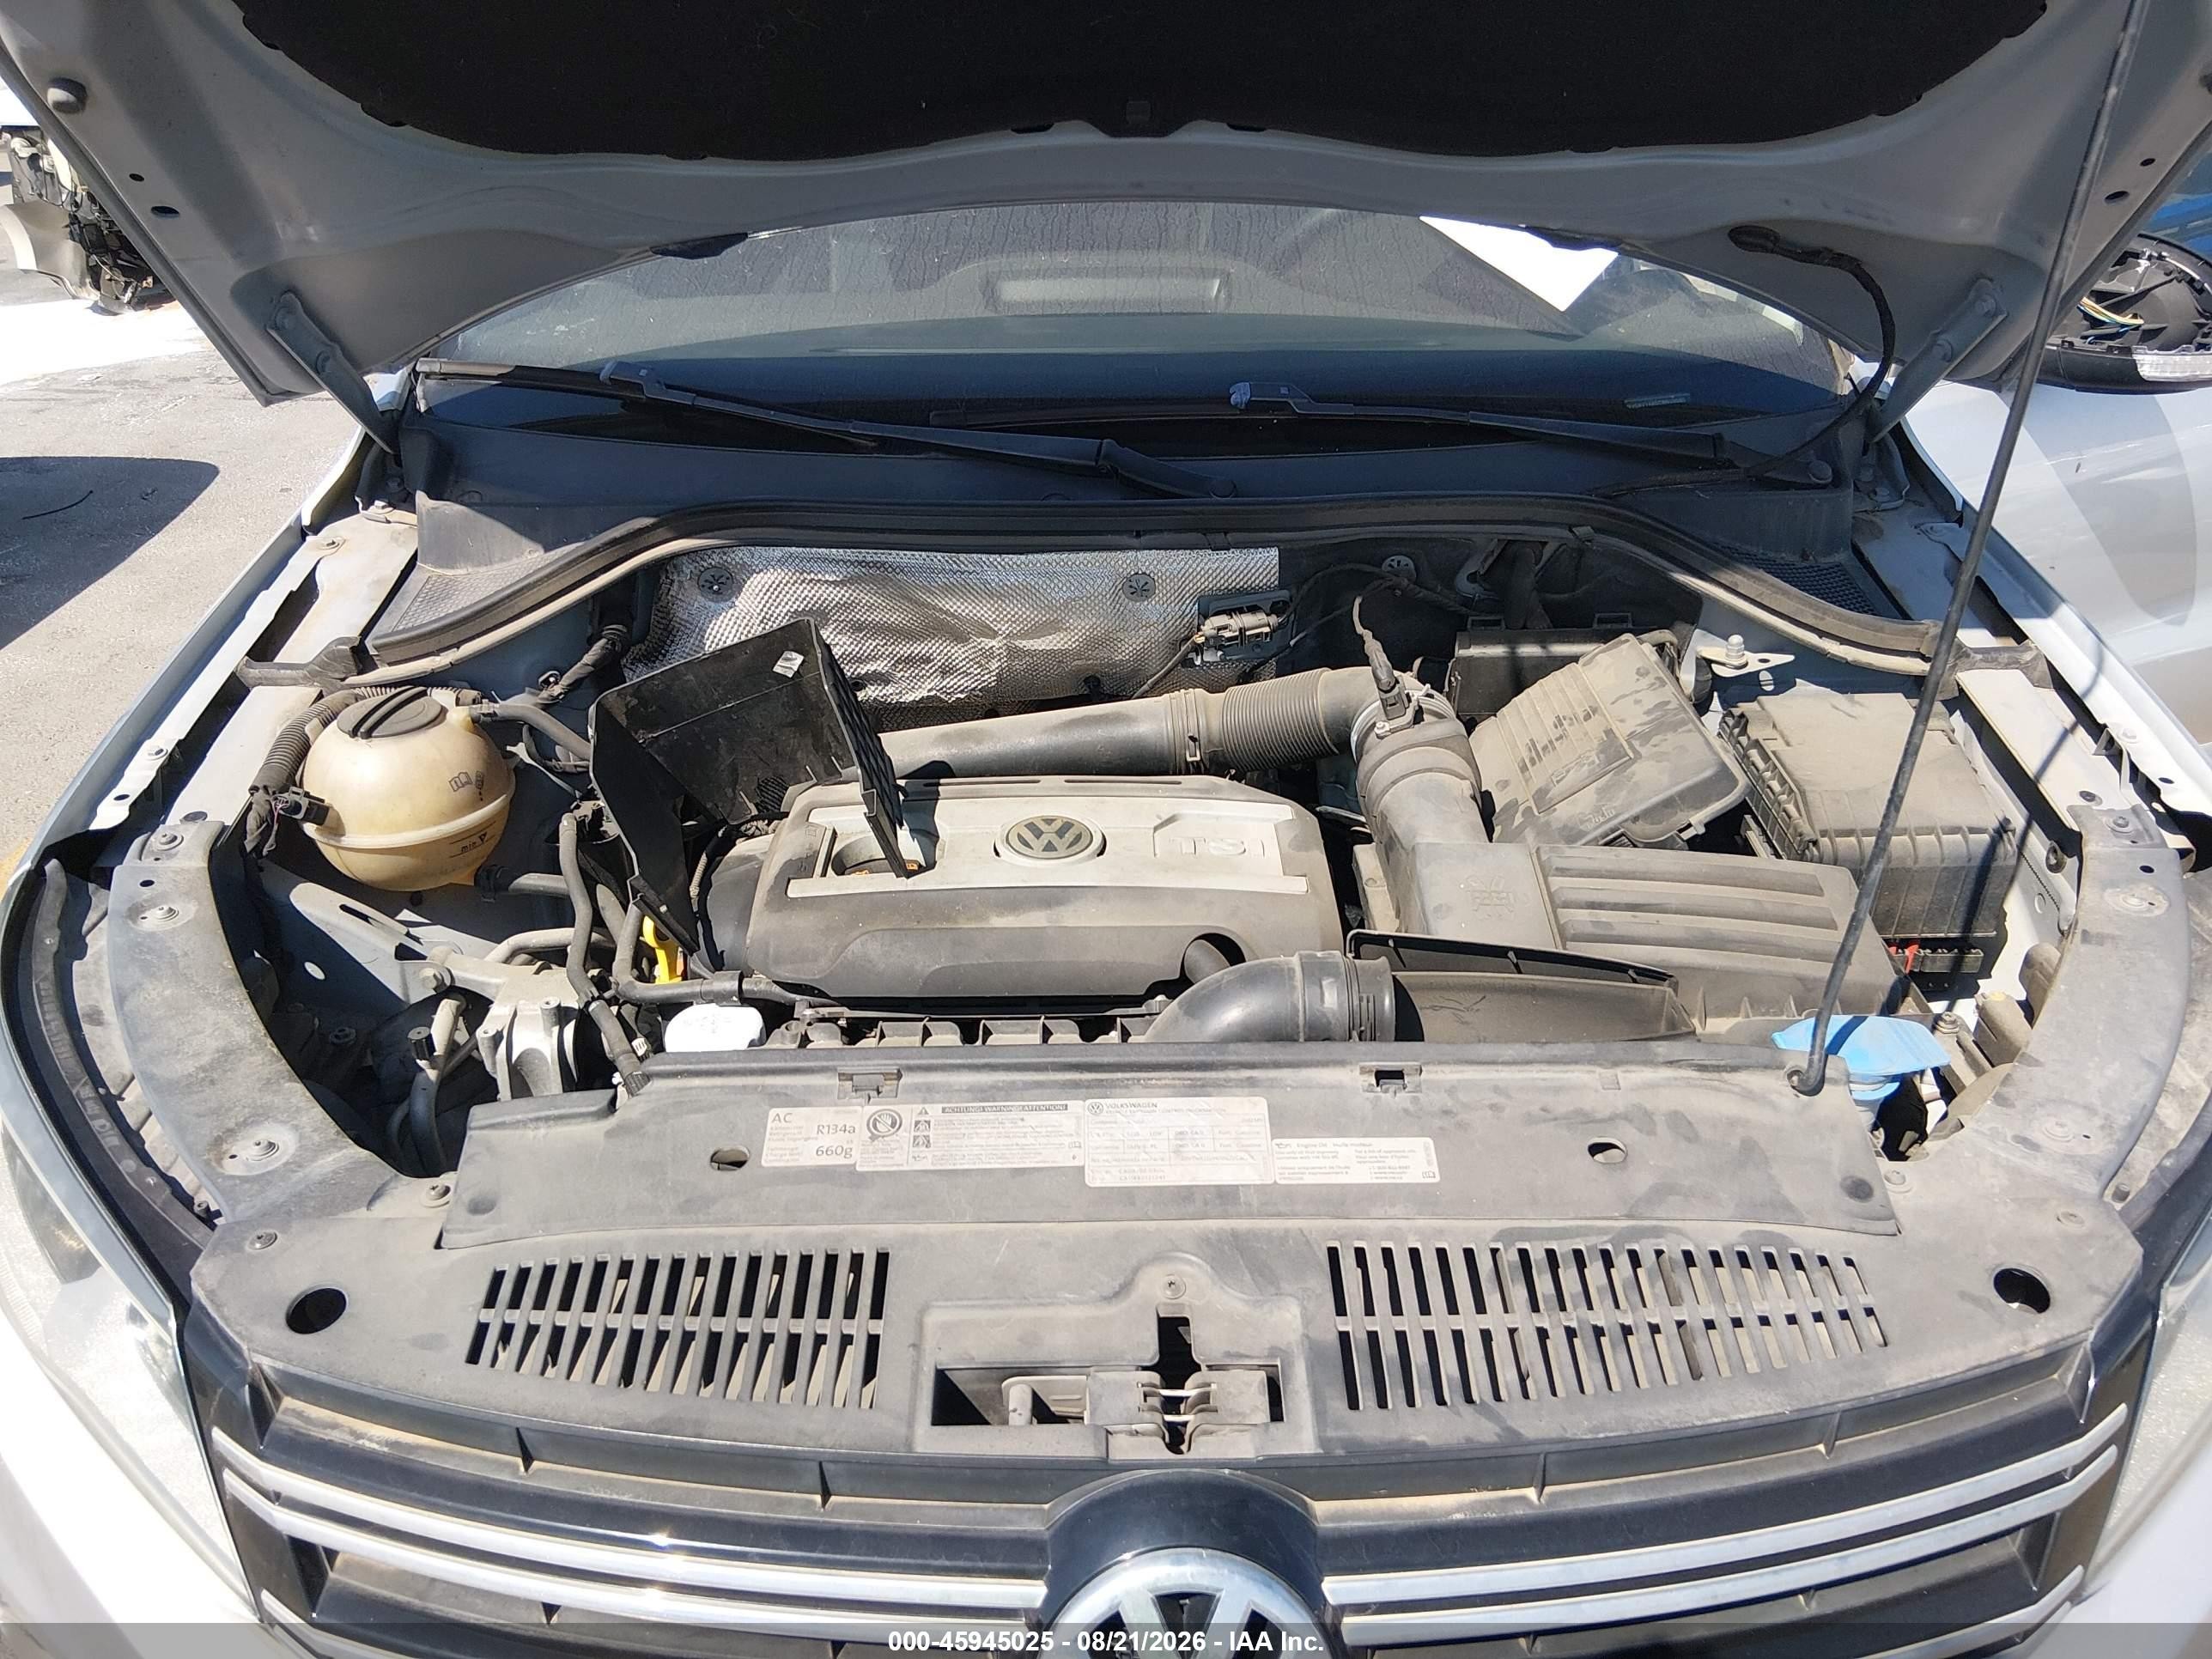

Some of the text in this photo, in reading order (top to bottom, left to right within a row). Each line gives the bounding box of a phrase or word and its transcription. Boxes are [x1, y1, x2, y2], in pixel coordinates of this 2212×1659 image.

[1170, 836, 1266, 858] TSI
[772, 1113, 793, 1123] AC
[817, 1123, 856, 1134] R134a
[816, 1145, 853, 1159] 660g
